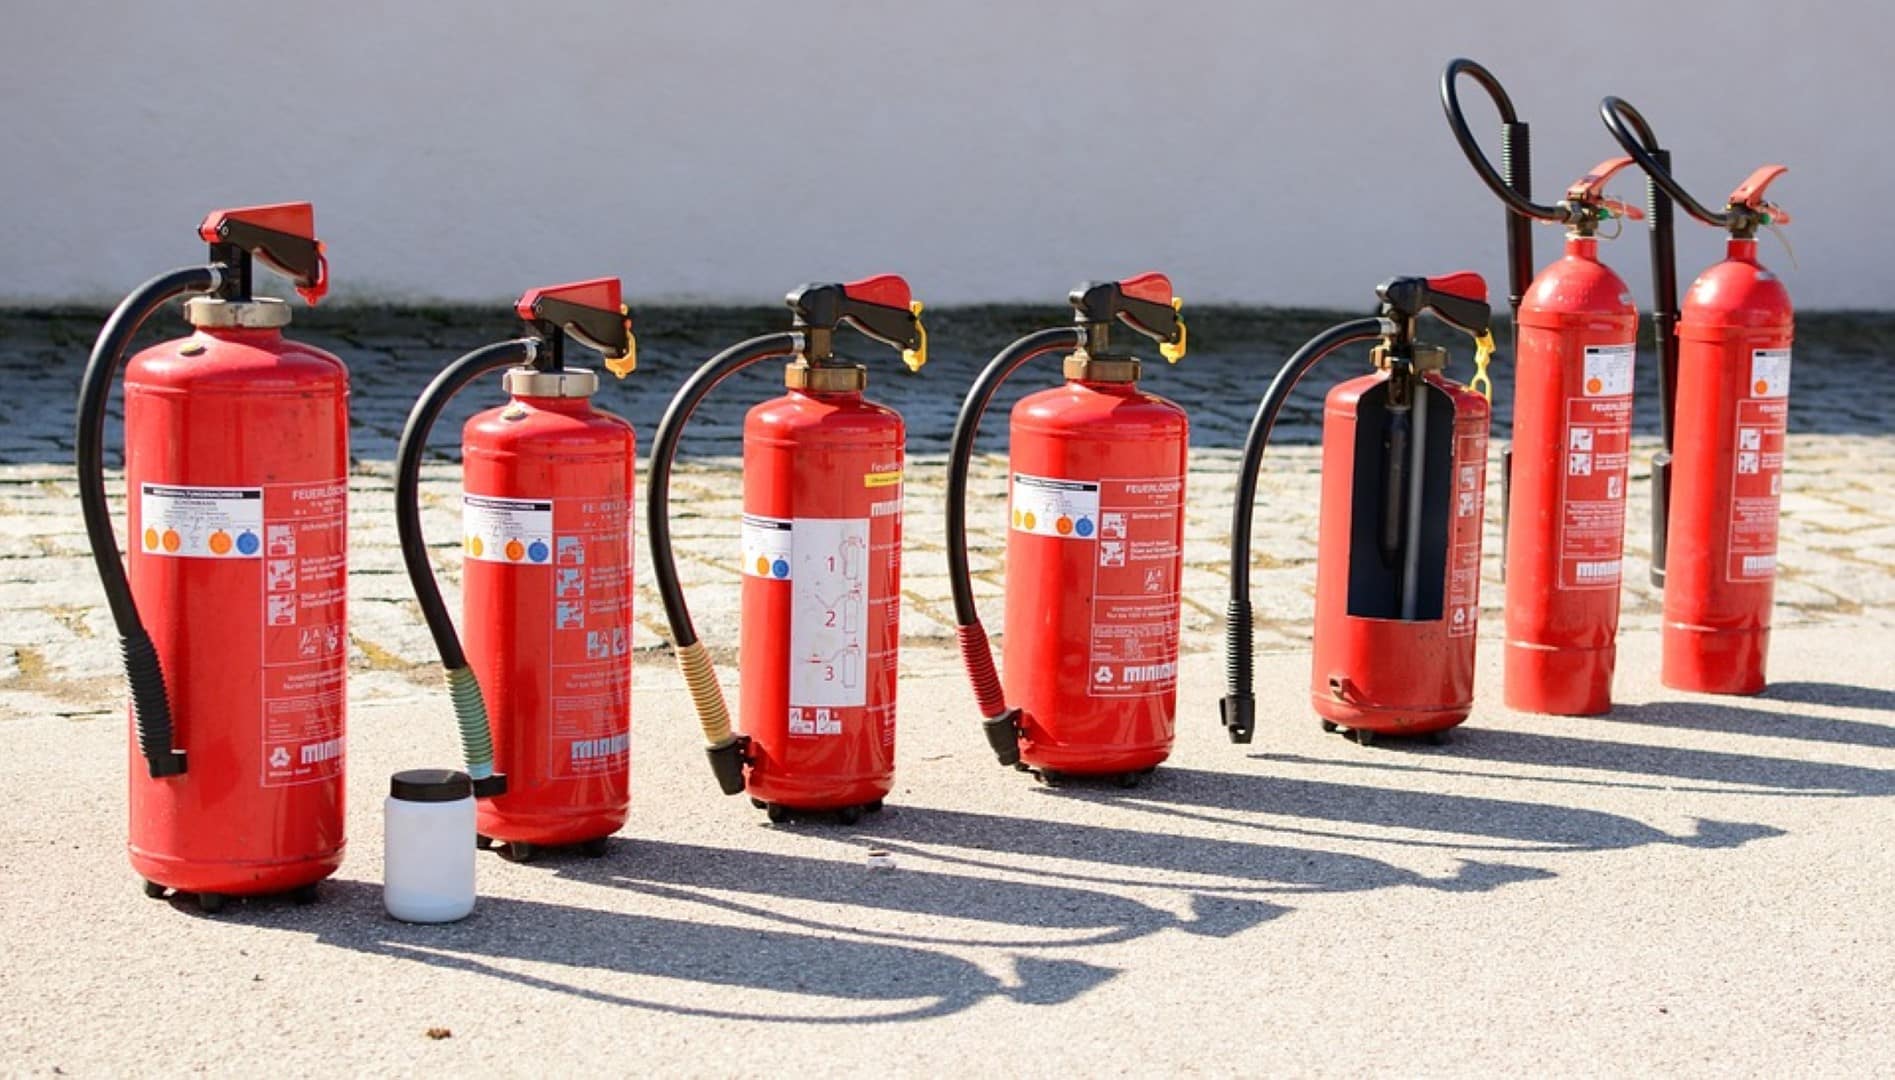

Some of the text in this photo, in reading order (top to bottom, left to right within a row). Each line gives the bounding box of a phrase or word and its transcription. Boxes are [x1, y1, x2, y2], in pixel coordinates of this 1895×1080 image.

[828, 556, 835, 572] 1
[825, 610, 836, 627] 2
[824, 666, 834, 681] 3
